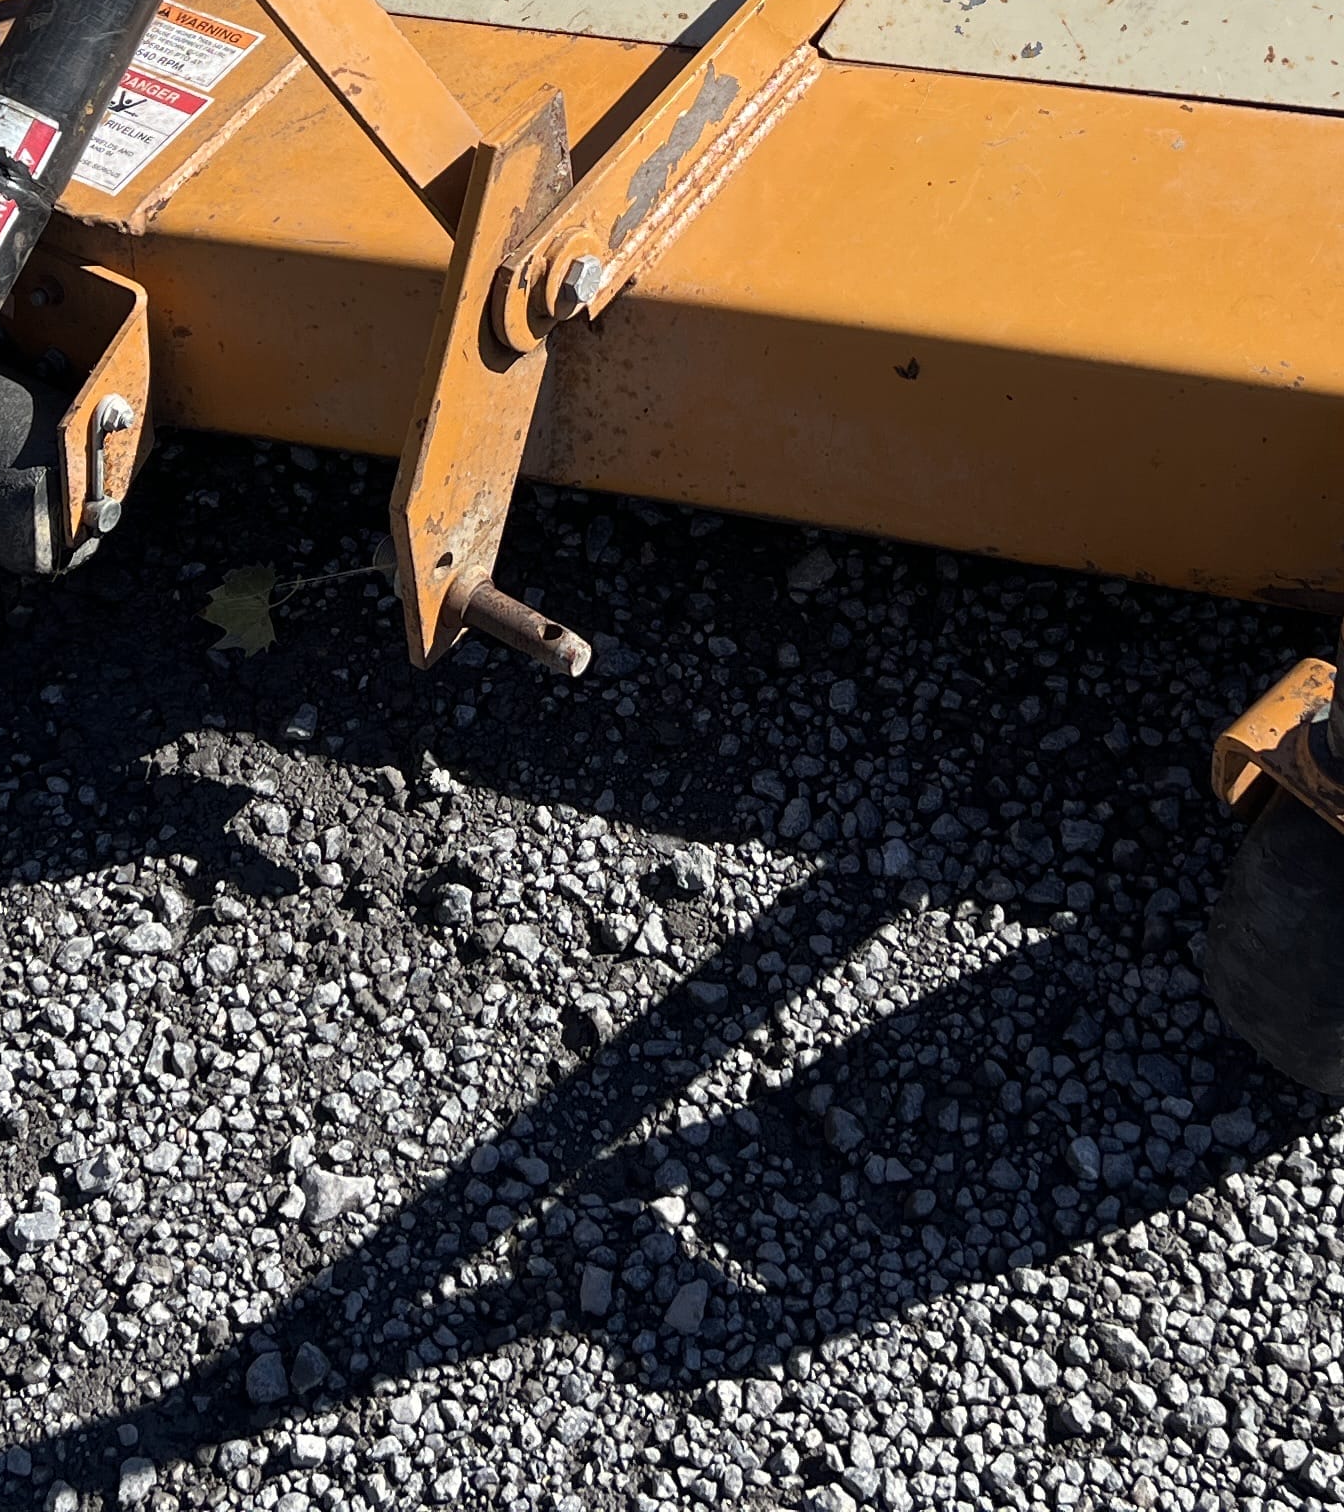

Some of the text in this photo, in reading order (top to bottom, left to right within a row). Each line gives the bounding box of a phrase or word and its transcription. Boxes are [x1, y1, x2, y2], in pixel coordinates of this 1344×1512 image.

[173, 12, 243, 43] WARNING
[134, 47, 159, 61] 540
[103, 119, 155, 144] RIVELINE
